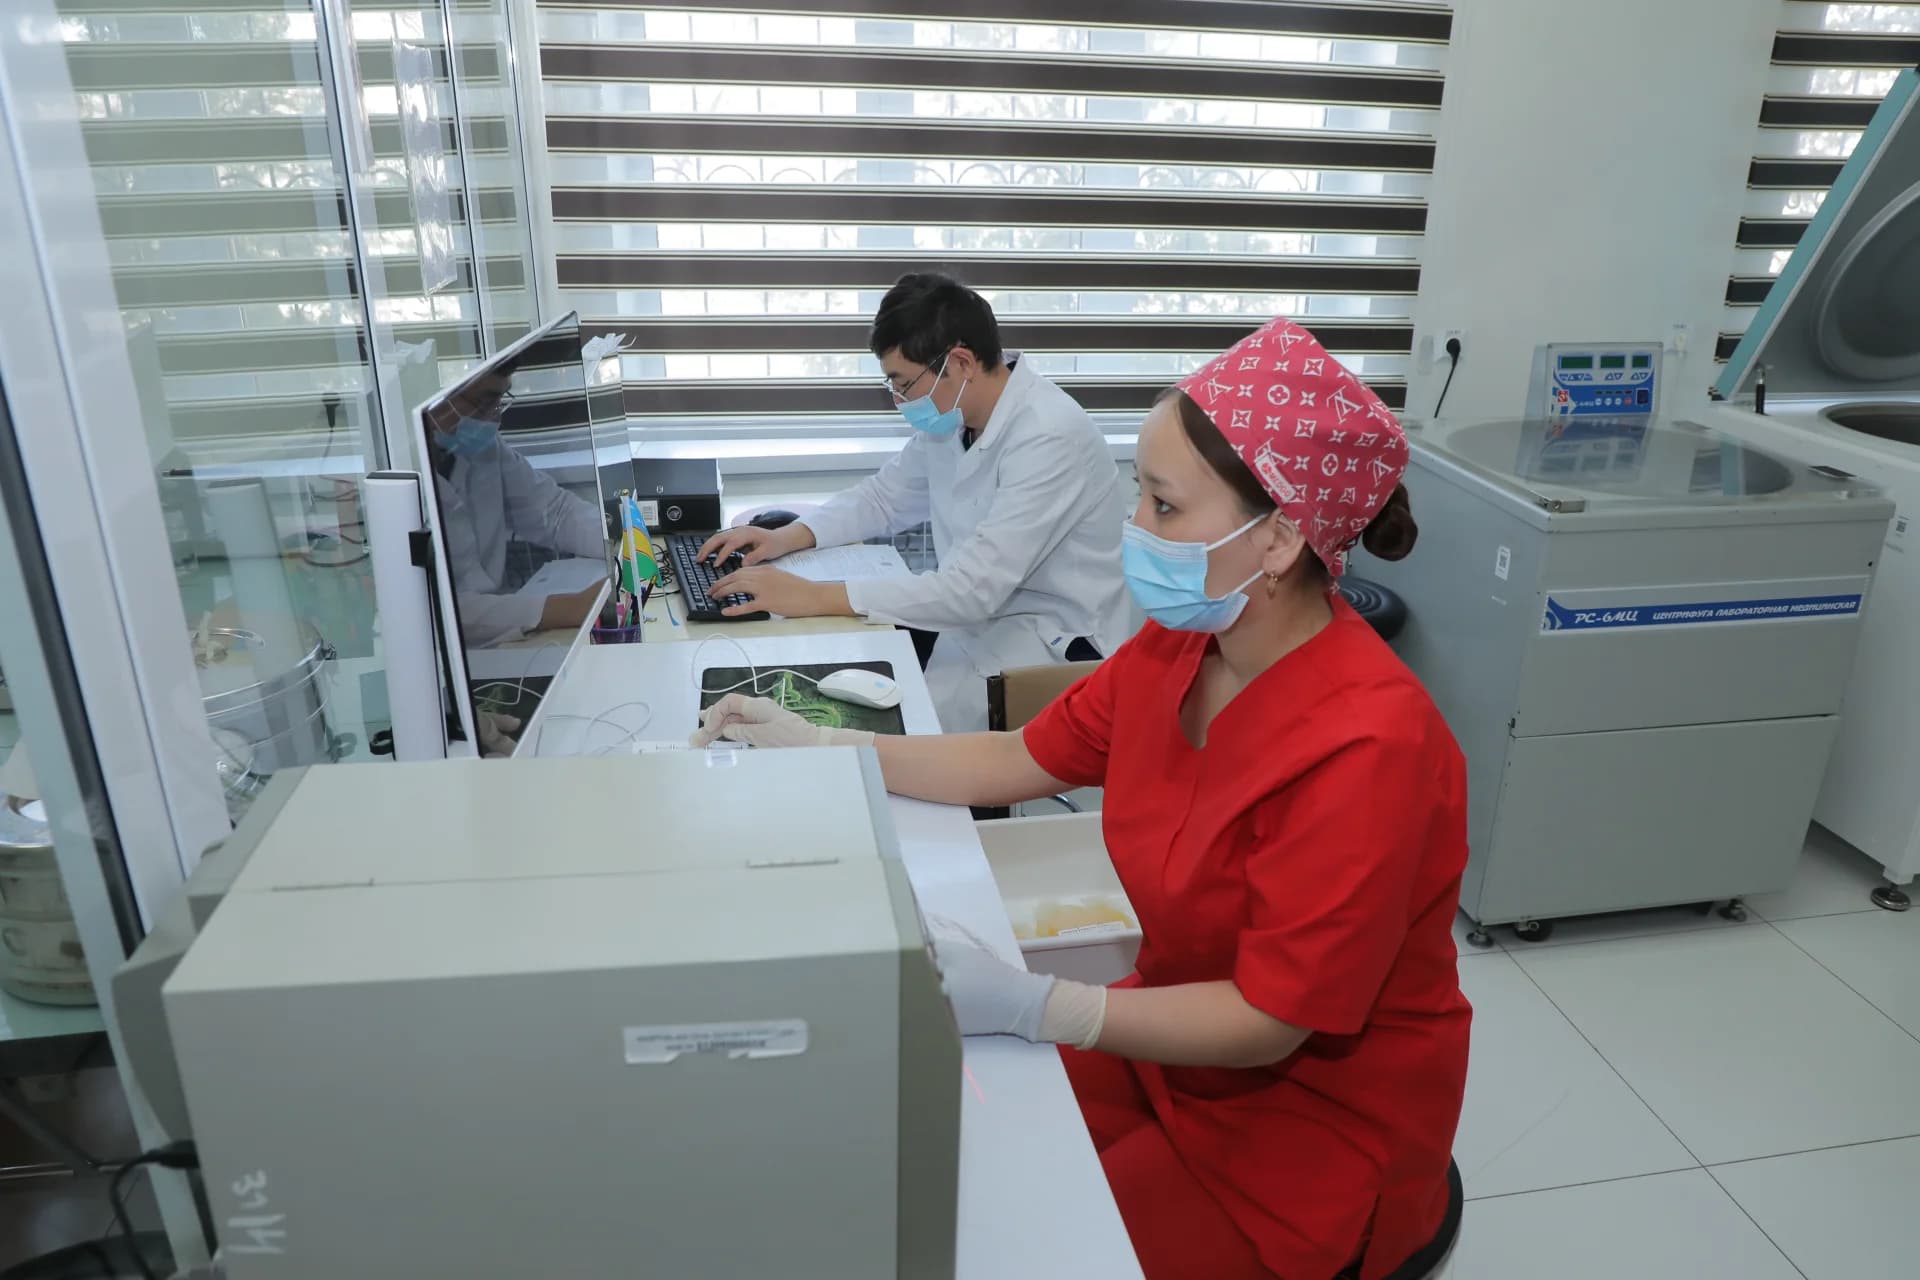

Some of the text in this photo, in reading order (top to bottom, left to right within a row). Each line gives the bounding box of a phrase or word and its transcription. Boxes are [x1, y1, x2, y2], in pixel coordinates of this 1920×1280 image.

[1652, 608, 1713, 620] ЦЕНТРИФУГА
[1715, 605, 1789, 617] ЛАБОРАТОРНАЯ
[1789, 601, 1857, 612] МЕДИЦИНСКАЯ
